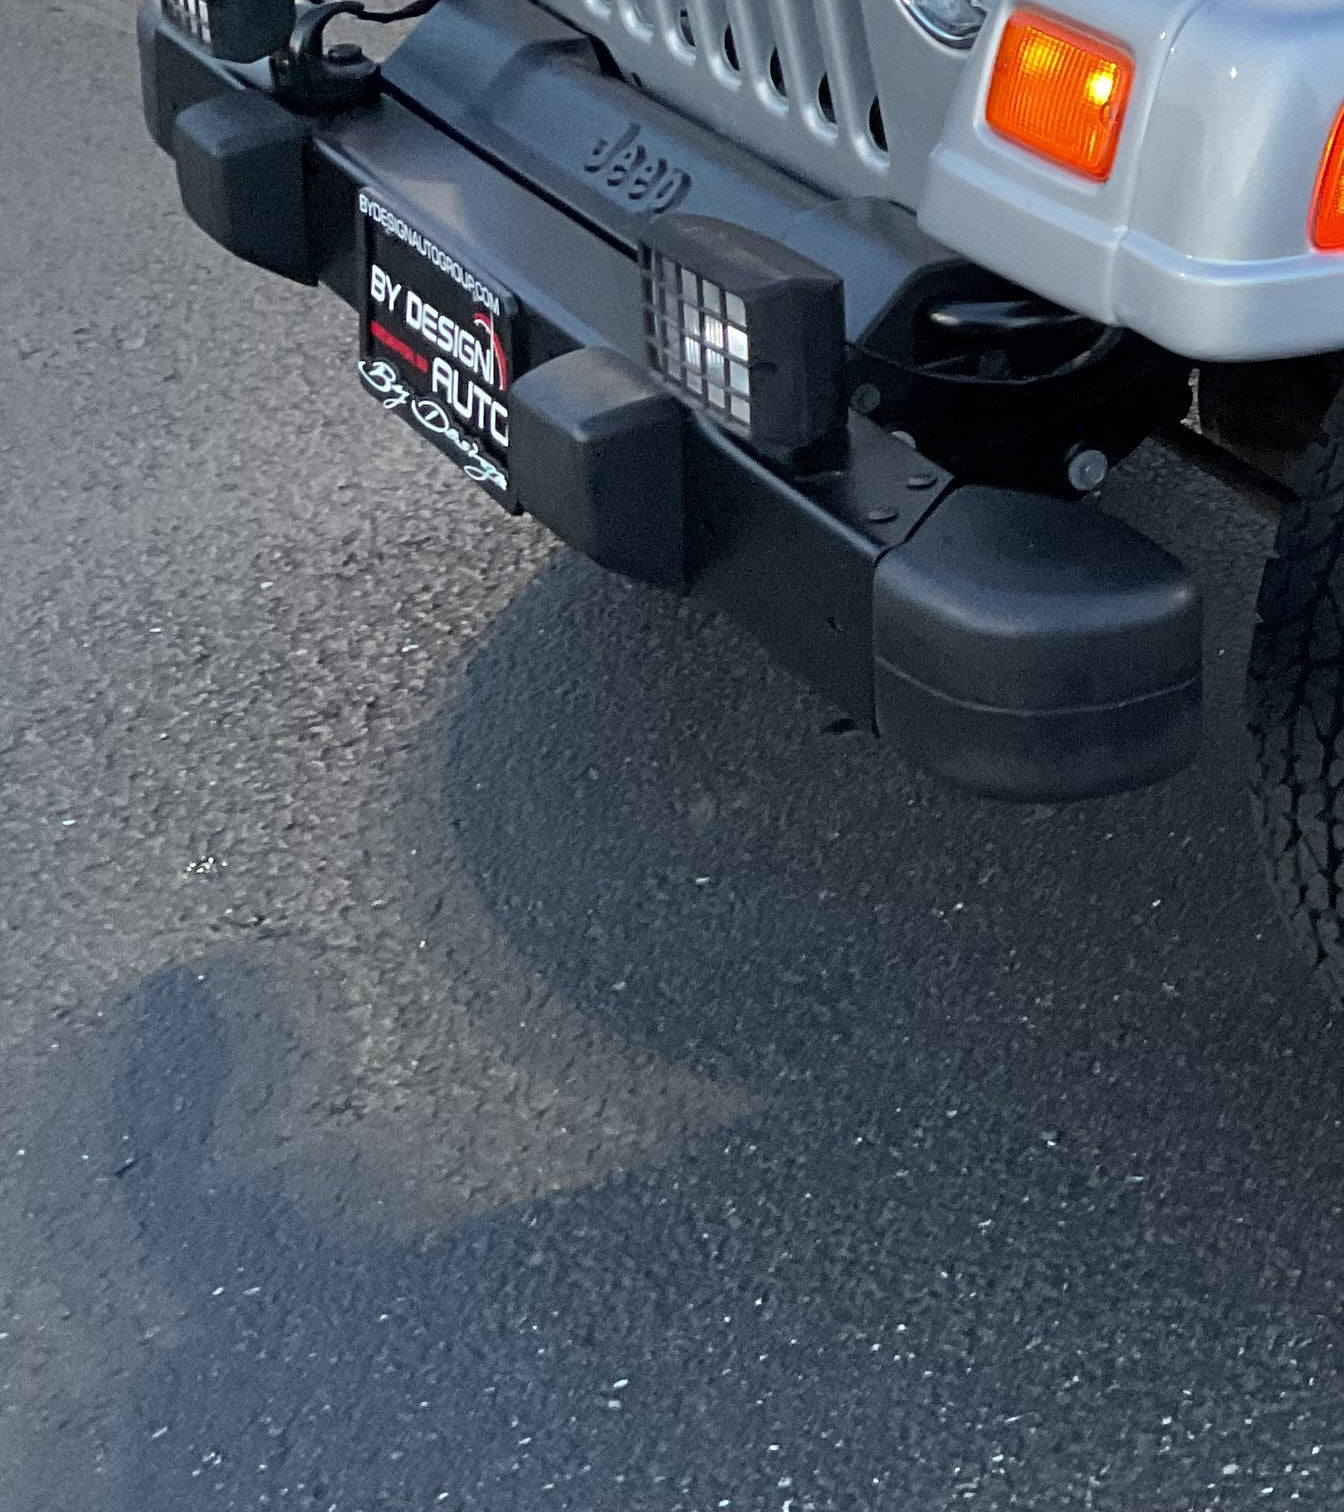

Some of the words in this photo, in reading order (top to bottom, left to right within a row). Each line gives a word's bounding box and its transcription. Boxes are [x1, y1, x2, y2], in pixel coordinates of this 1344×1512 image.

[584, 122, 693, 215] Jeep
[358, 193, 500, 316] BYDESIGNAUTOGROUP.COM
[370, 264, 402, 311] BY
[405, 290, 495, 385] DESIGN
[358, 360, 410, 409] By
